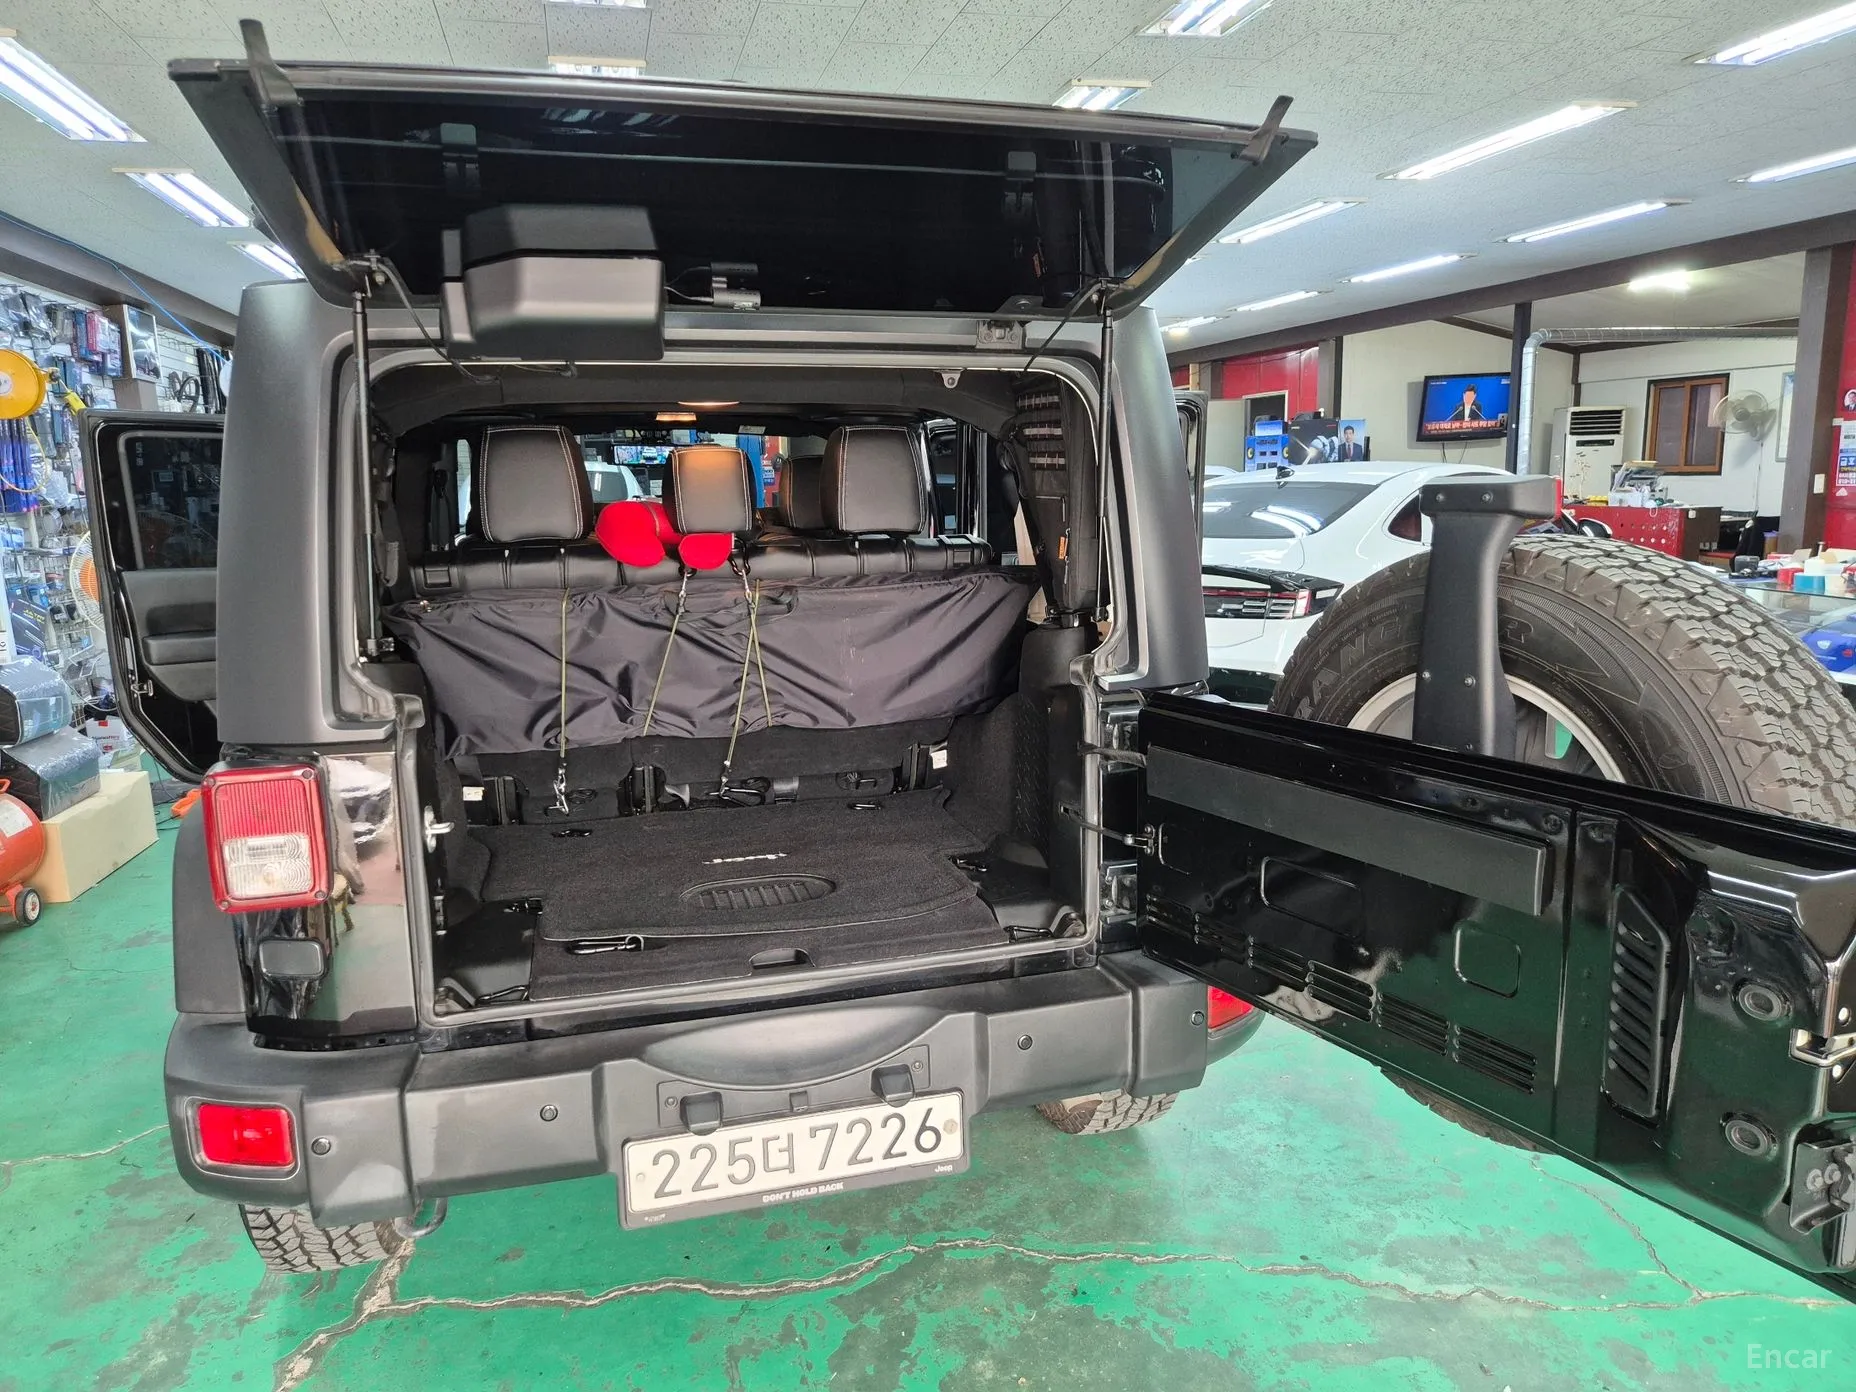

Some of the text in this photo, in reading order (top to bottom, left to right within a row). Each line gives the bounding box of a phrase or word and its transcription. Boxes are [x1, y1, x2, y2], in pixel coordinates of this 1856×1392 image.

[651, 1107, 942, 1199] 225더 7226
[762, 1182, 844, 1203] DON'T HOLD BACK
